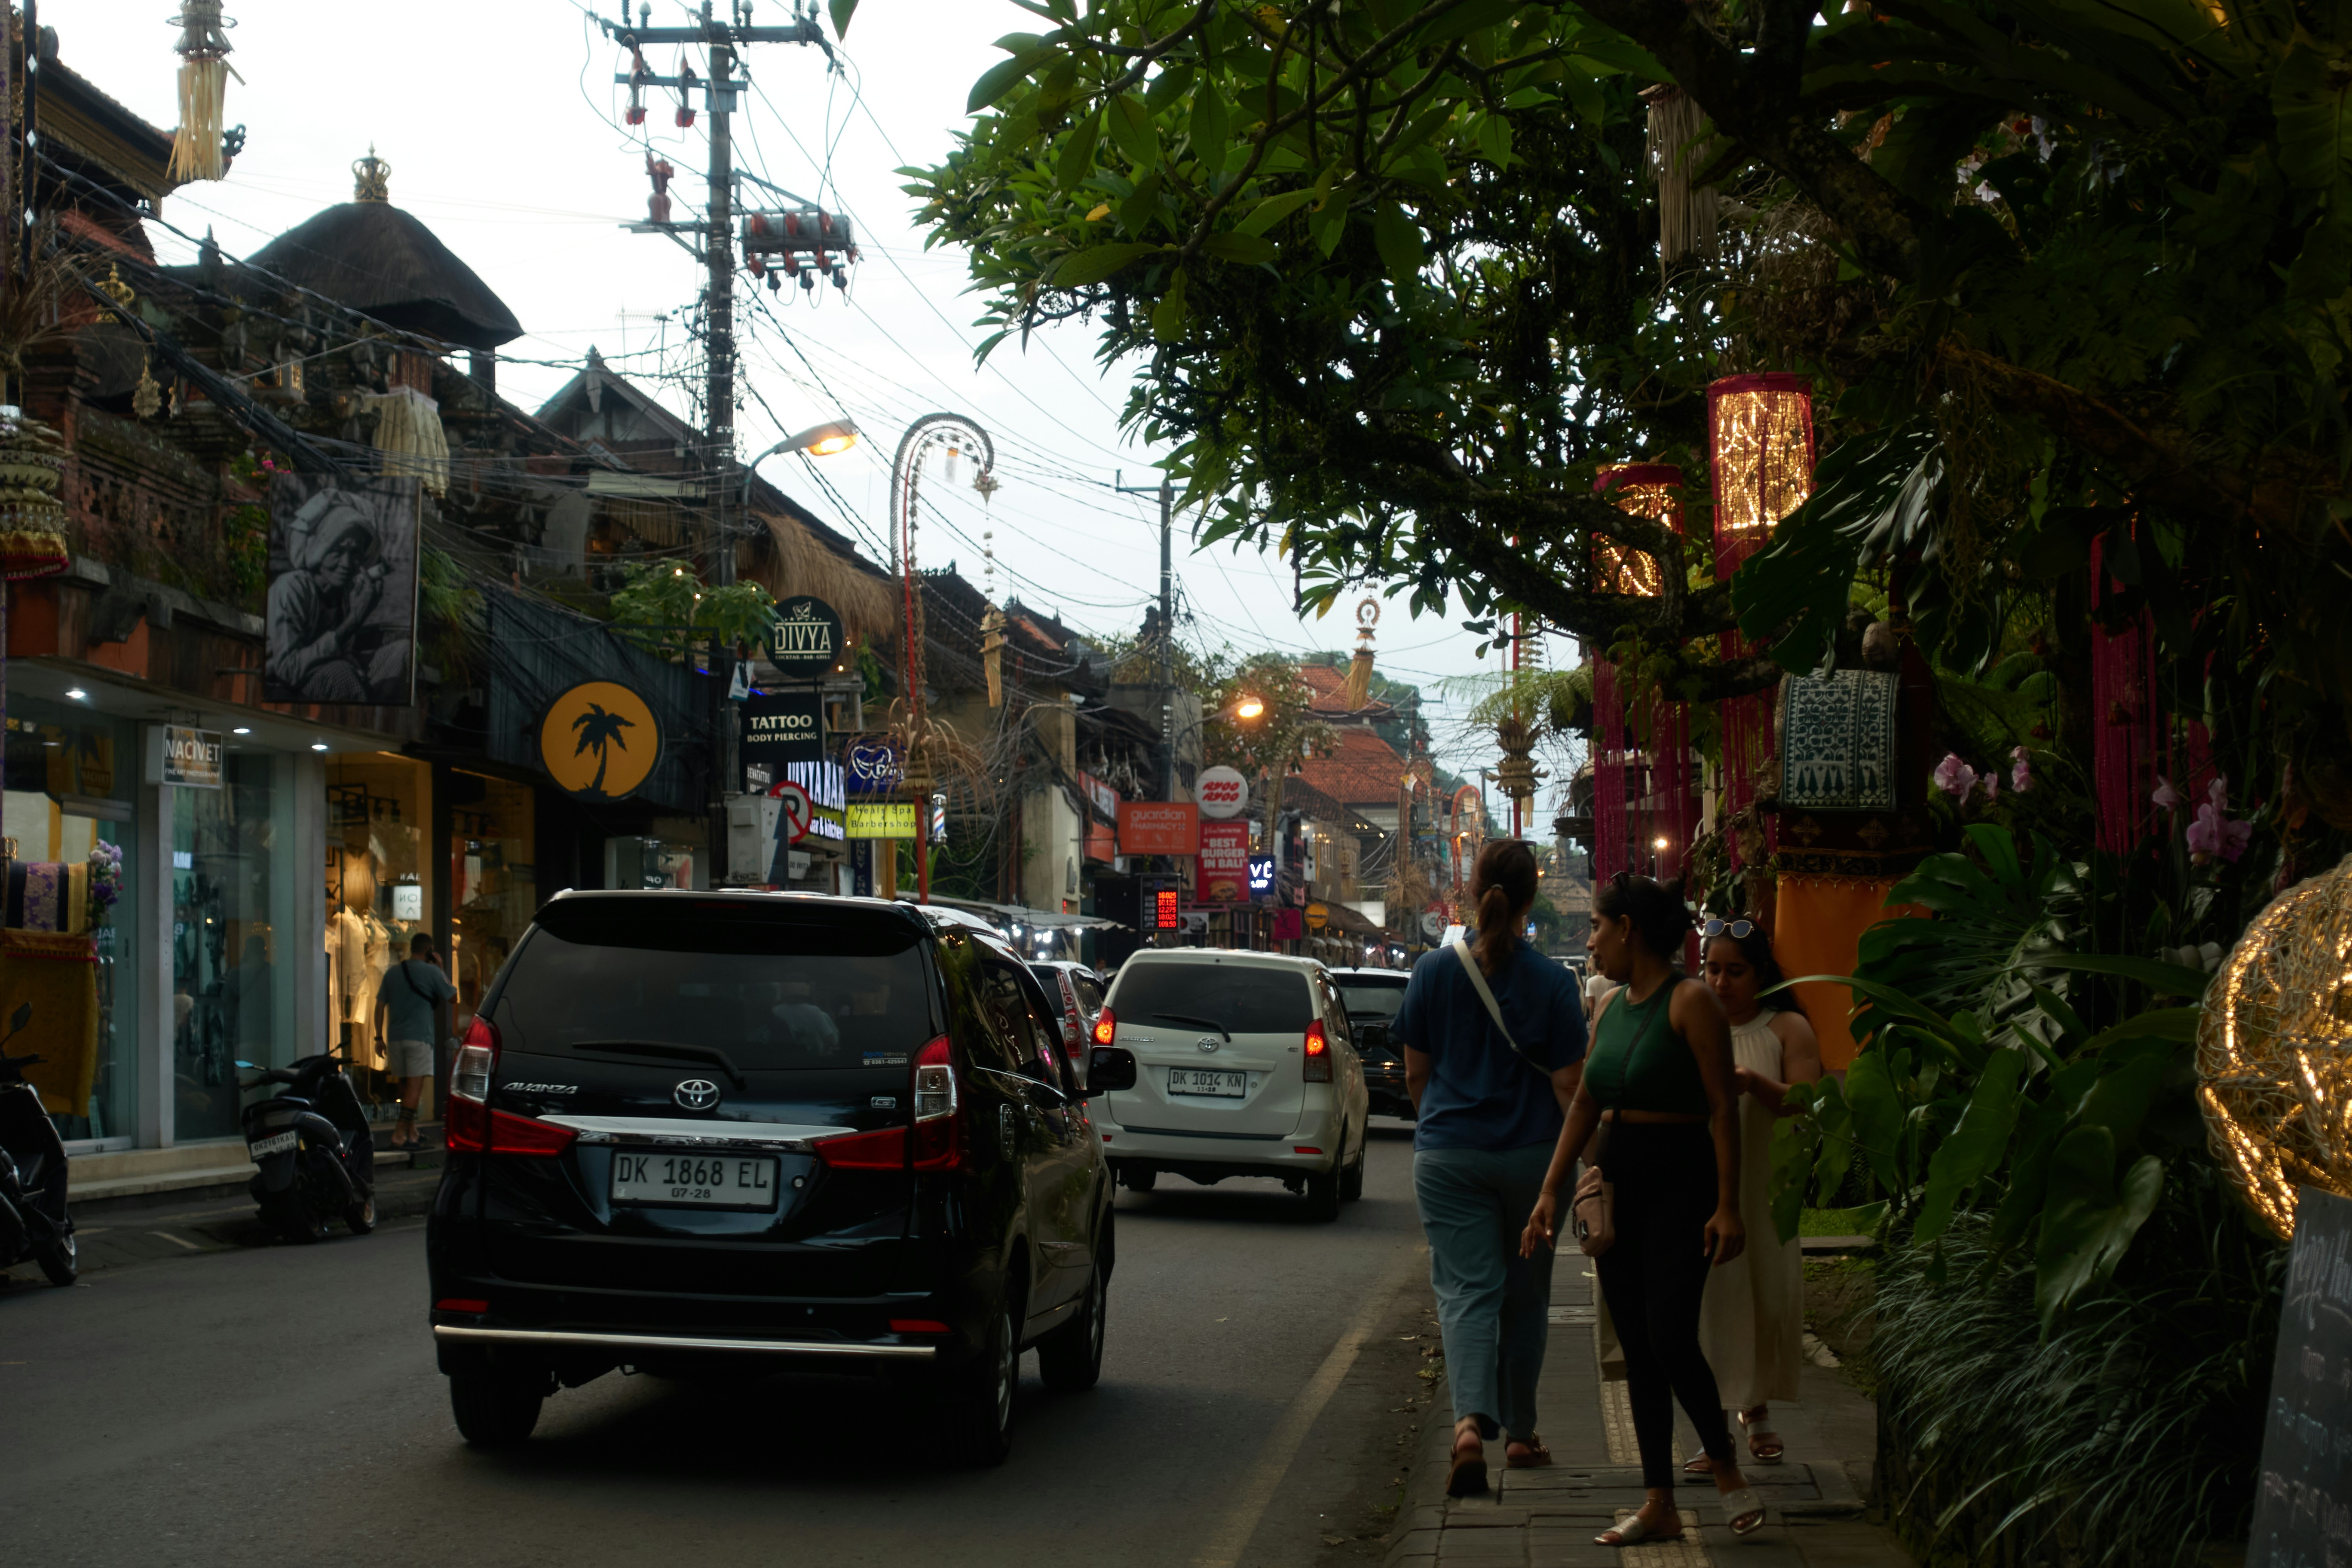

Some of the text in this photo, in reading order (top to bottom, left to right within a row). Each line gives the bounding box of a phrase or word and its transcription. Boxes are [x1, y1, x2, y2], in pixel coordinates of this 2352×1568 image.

[775, 626, 831, 650] DIVYA
[750, 715, 812, 729] TATTOO
[747, 732, 817, 743] BODY PIERCING
[165, 767, 176, 775] FINE
[186, 769, 219, 778] PHOTOGRAPHY
[823, 760, 845, 812] BAR
[891, 807, 911, 816] Spa
[1130, 809, 1185, 821] guardian
[824, 818, 844, 841] kitchen
[851, 820, 916, 829] Barbershop
[1201, 848, 1245, 858] BURGER
[1204, 858, 1216, 868] IN
[1173, 1072, 1241, 1087] DK 1014 KN
[502, 1082, 579, 1094] AVANZA
[618, 1157, 767, 1188] DK 1868 EL
